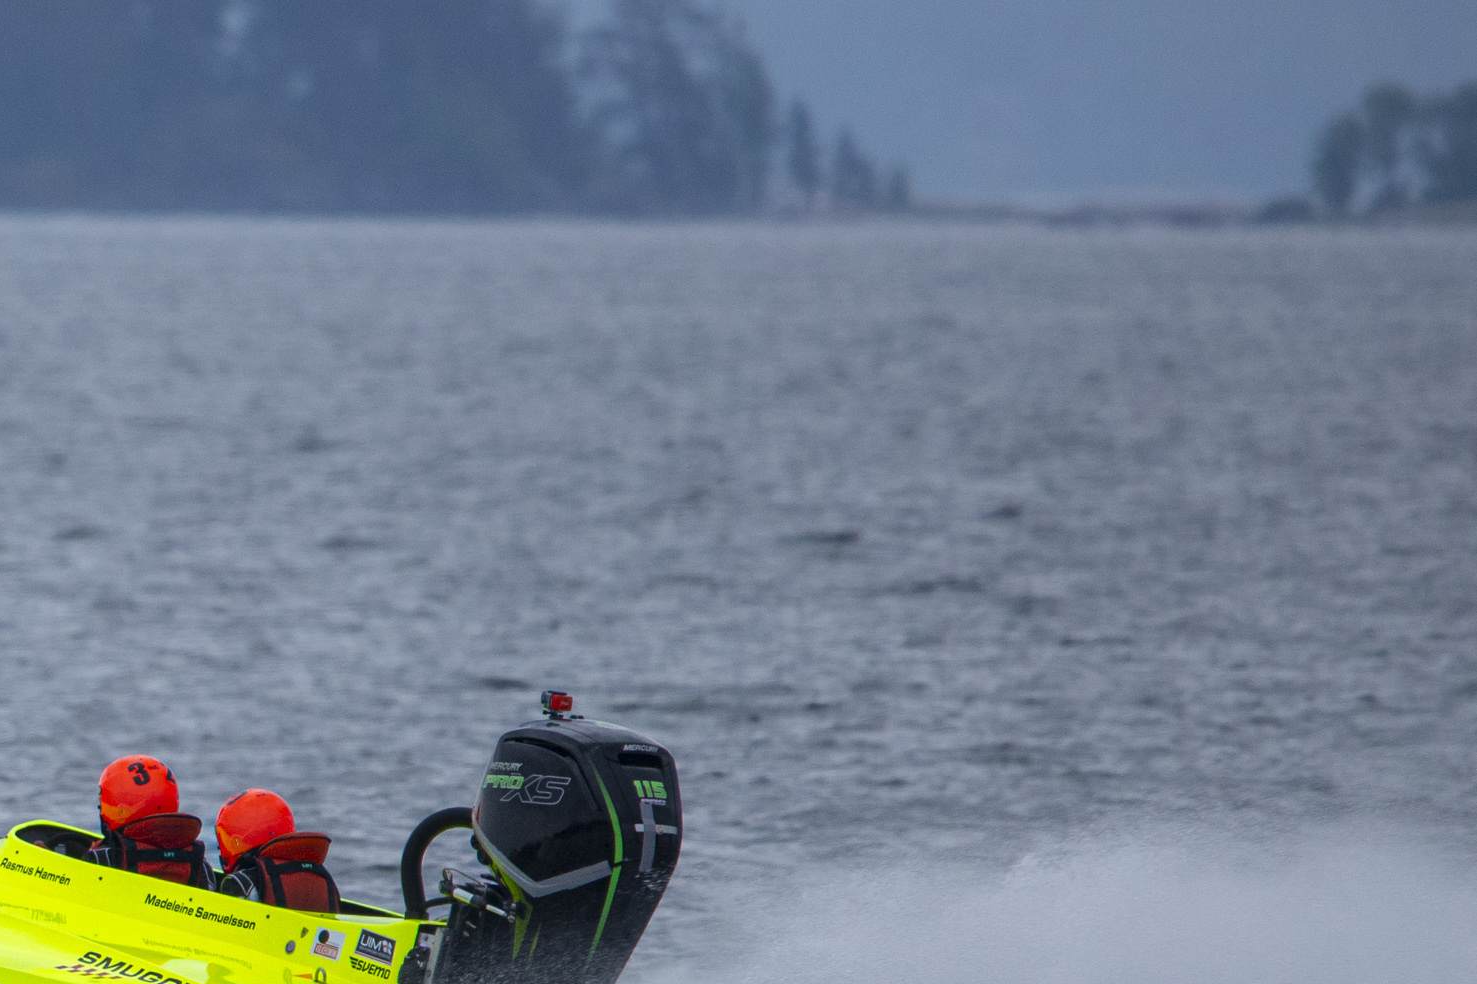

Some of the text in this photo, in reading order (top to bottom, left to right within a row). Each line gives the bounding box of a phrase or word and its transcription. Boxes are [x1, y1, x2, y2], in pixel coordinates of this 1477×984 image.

[623, 744, 659, 753] MERCURY
[491, 761, 523, 771] MERCURY
[483, 774, 571, 805] PRO XS
[633, 780, 667, 799] 115
[0, 857, 34, 876] Rasmus
[35, 866, 71, 886] Hamrén
[144, 893, 256, 930] Madeleine Samuelsson
[360, 933, 382, 952] UIM
[355, 959, 391, 980] SVEMO
